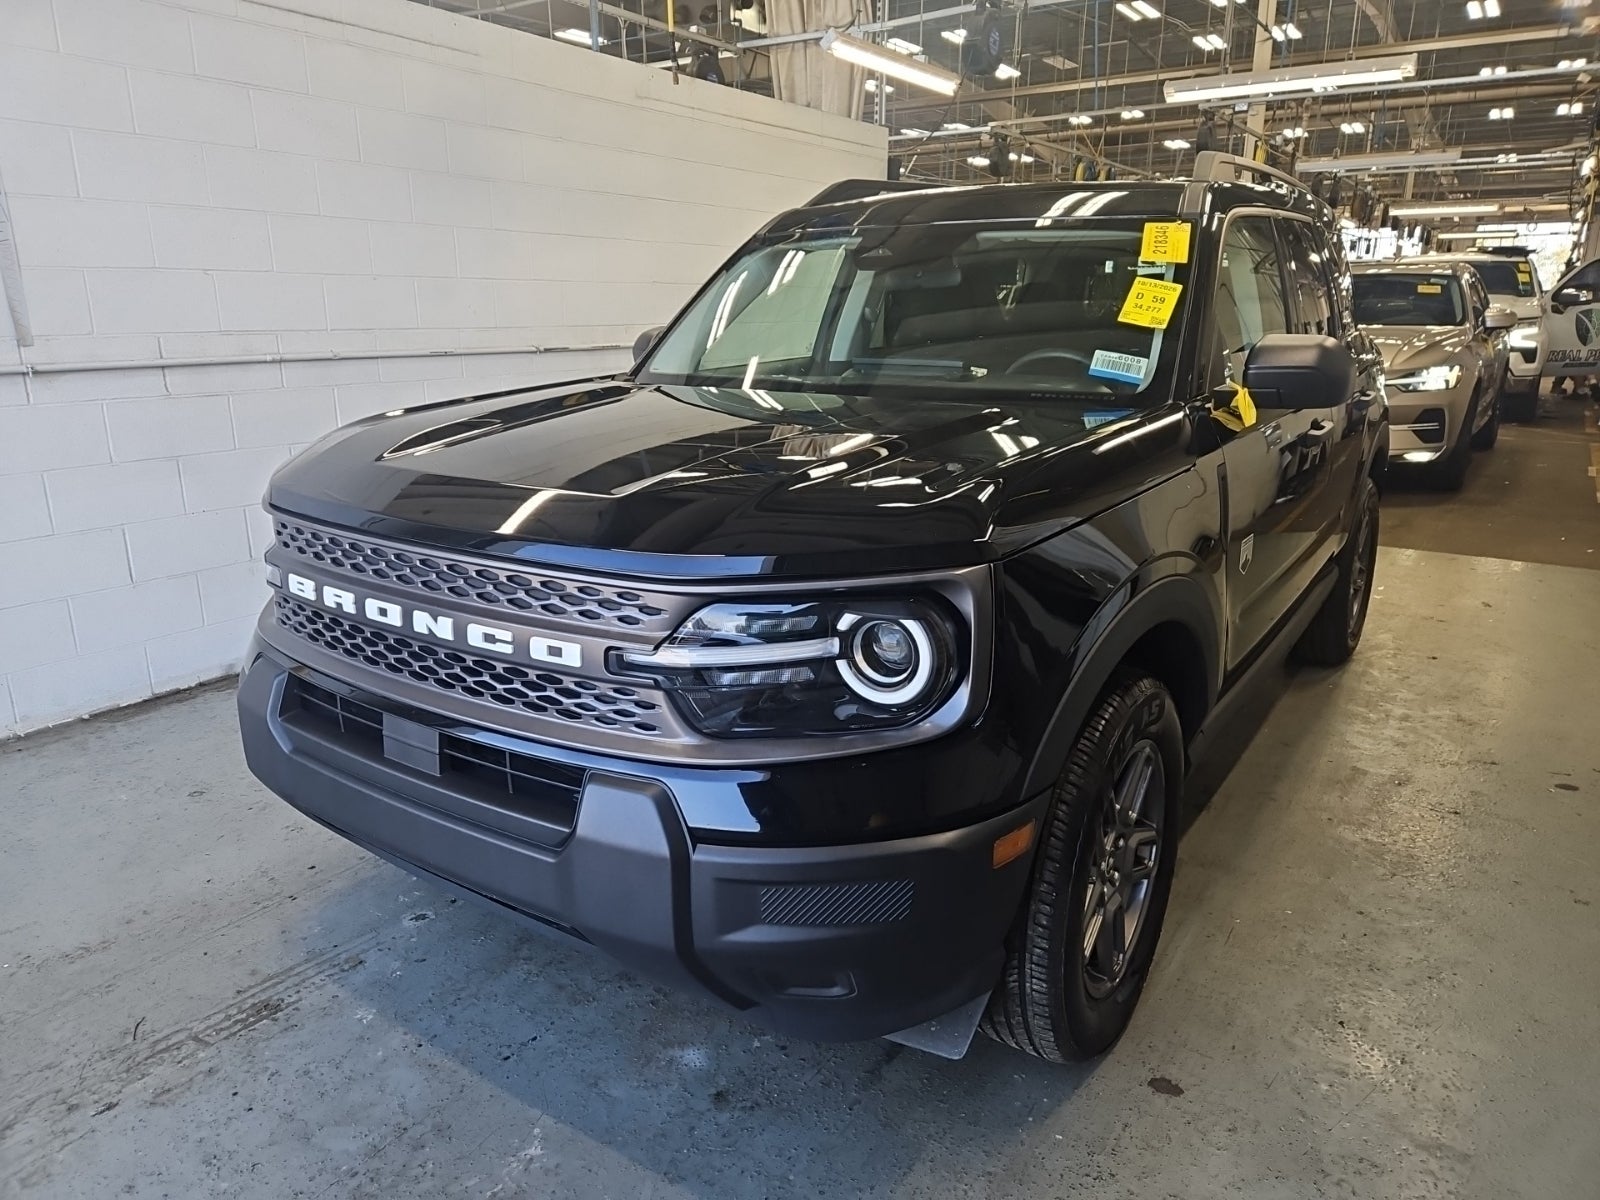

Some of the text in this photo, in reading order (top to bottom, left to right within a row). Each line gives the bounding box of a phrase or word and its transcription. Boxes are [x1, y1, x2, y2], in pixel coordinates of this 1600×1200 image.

[1153, 225, 1169, 254] 218346
[1136, 292, 1166, 304] D 59
[1547, 349, 1582, 362] REAL
[288, 573, 582, 668] BRONCO
